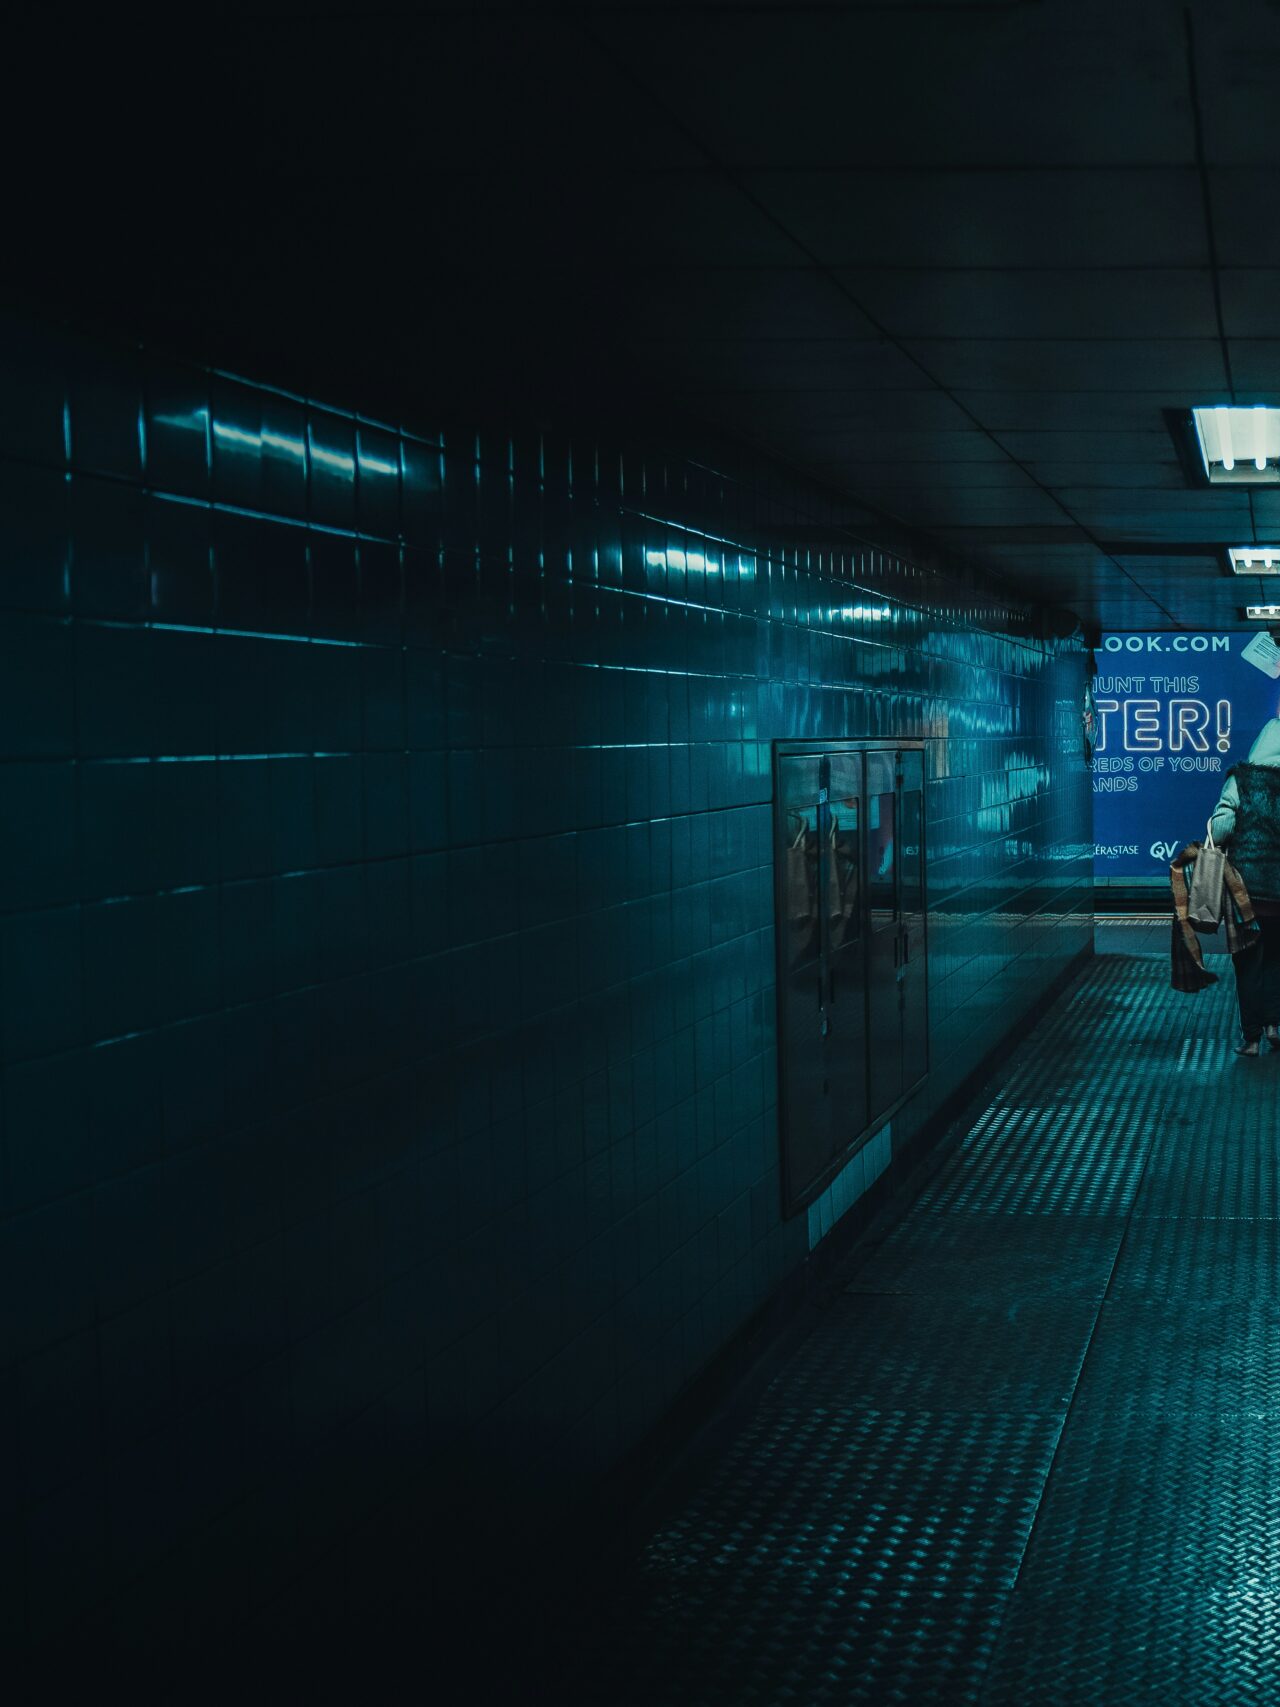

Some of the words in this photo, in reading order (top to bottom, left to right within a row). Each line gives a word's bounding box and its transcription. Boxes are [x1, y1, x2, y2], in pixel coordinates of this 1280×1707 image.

[1150, 676, 1200, 693] THIS
[1138, 757, 1165, 772] OF
[1168, 757, 1221, 772] YOUR
[1093, 843, 1139, 856] ÉRASTASE
[1150, 841, 1178, 861] QV
